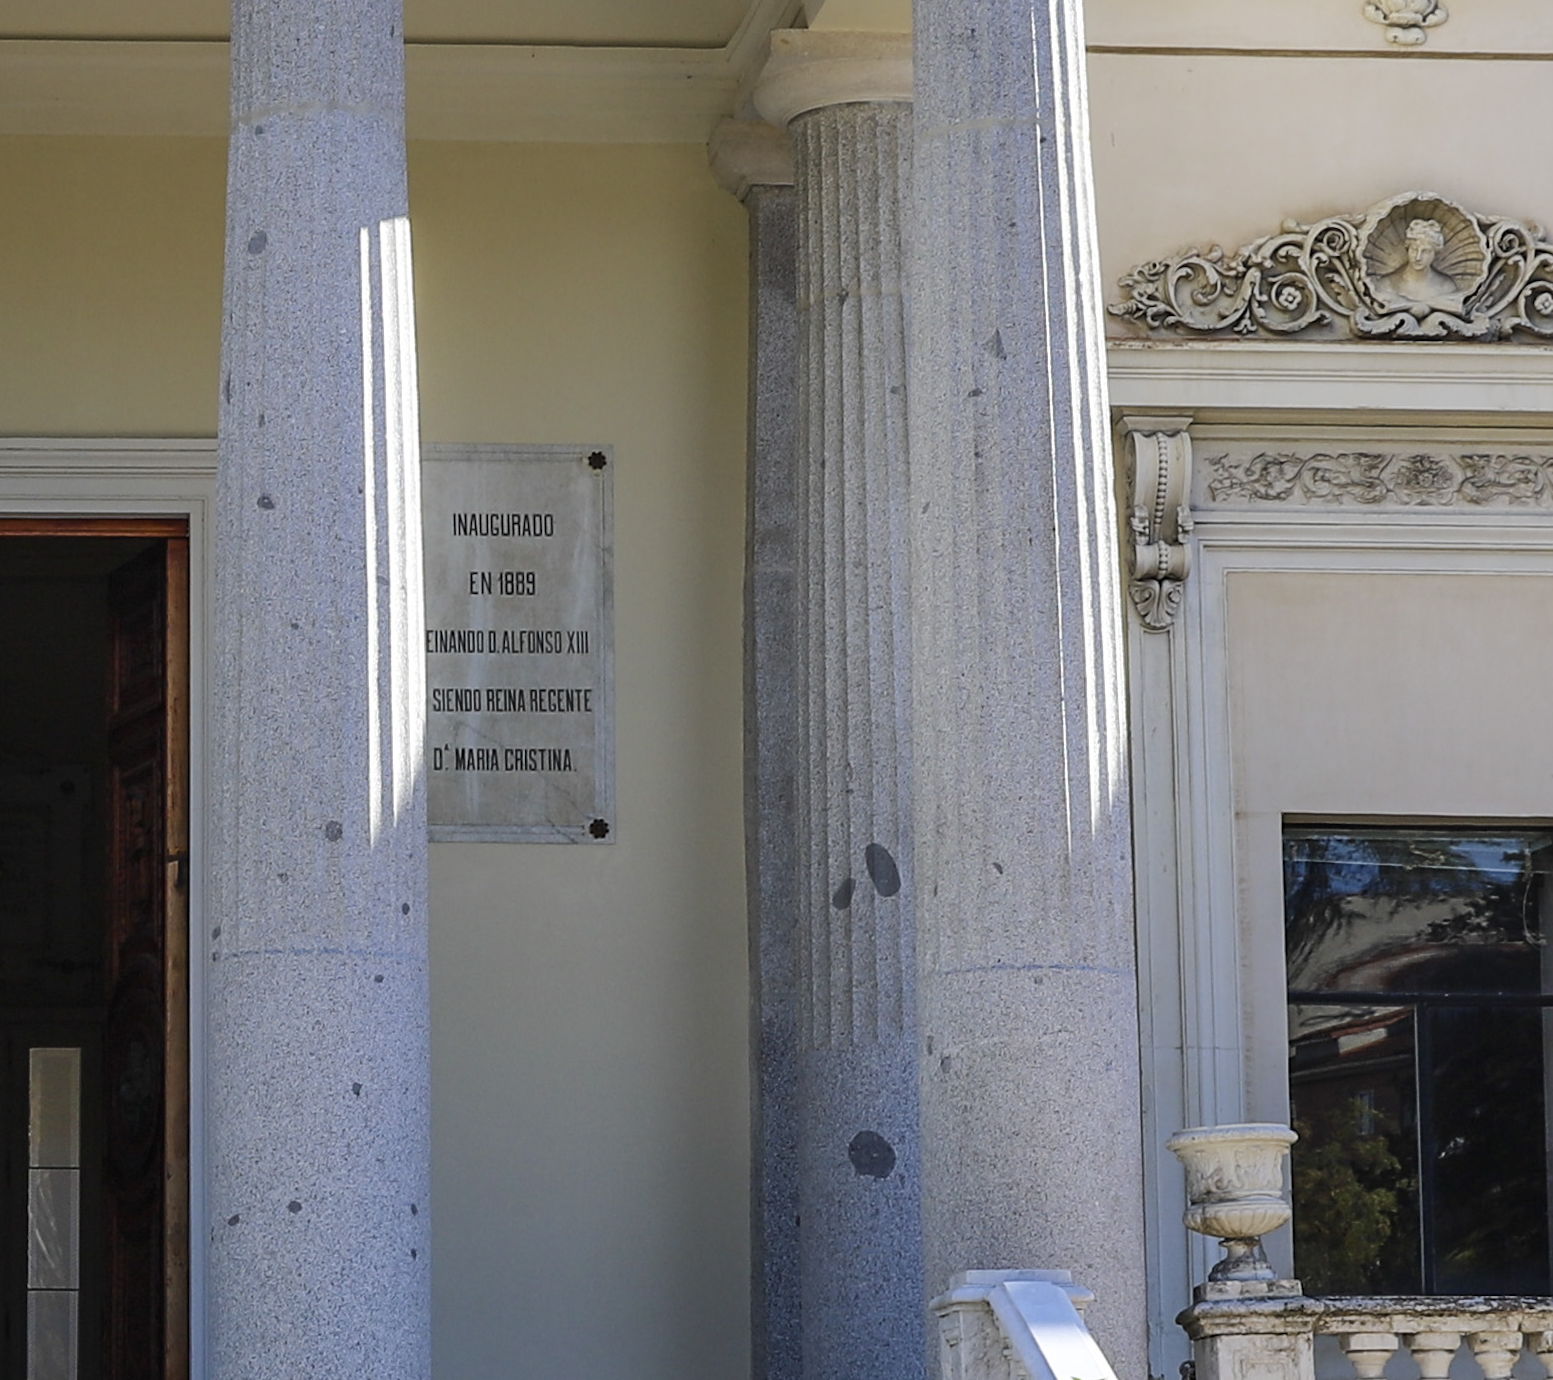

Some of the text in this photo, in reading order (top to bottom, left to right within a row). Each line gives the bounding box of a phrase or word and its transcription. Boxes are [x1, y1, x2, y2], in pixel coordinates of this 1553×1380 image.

[452, 512, 554, 537] INAUGURADO
[469, 571, 537, 596] EN 1889
[426, 629, 484, 654] EINANDO
[567, 631, 589, 654] XIII
[432, 688, 593, 713] SIENDO REINA REGENTE
[455, 747, 500, 772] MARIA
[504, 748, 578, 772] CRISTINA.
